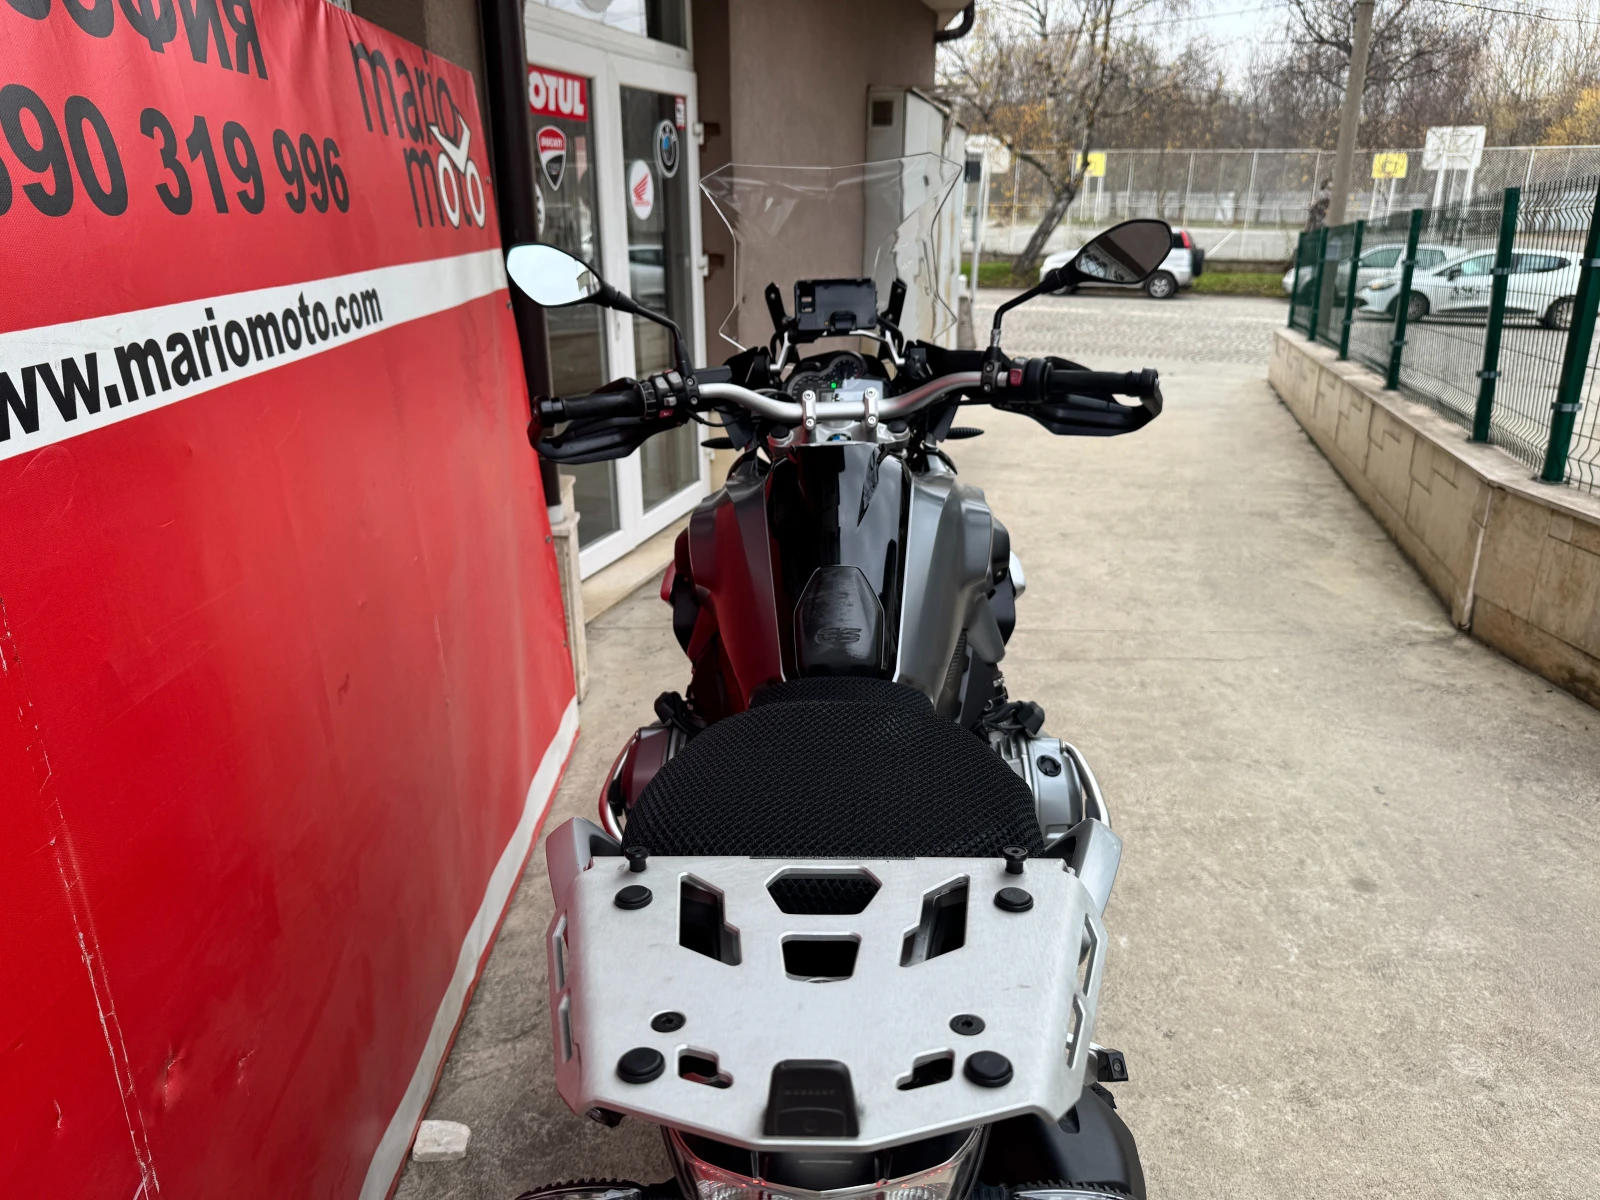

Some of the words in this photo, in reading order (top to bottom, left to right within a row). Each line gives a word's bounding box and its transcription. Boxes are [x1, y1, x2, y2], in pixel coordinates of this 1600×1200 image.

[349, 39, 460, 146] mario
[0, 83, 129, 217] 90
[140, 107, 265, 216] 319
[272, 128, 349, 214] 996
[402, 147, 486, 230] moto
